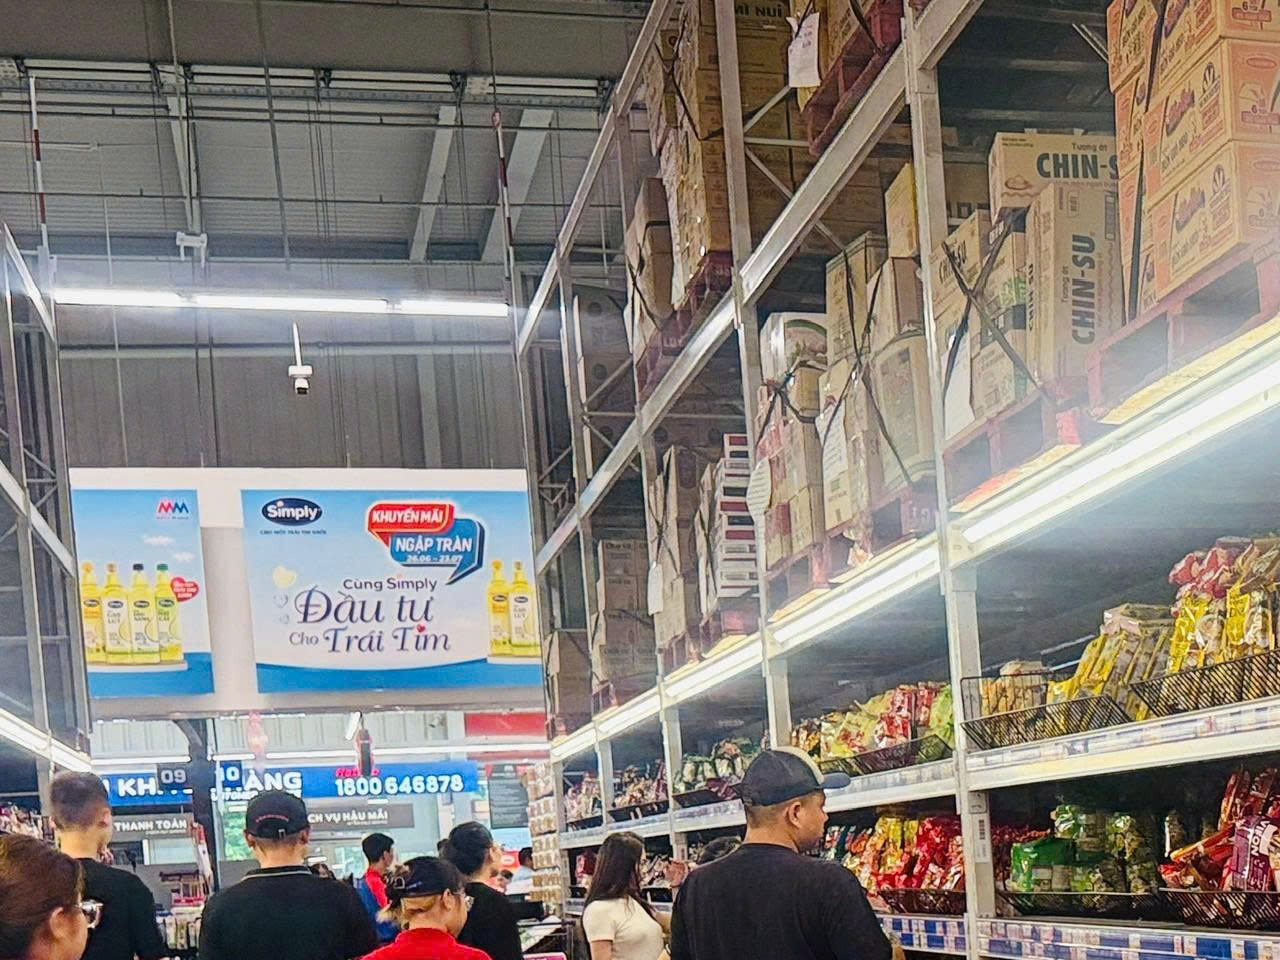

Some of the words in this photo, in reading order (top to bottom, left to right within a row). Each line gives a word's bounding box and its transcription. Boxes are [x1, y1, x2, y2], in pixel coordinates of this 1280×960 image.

[1036, 153, 1118, 180] CHIN-S
[1072, 233, 1096, 345] CHIN-SU
[266, 500, 319, 521] Simply
[395, 536, 434, 557] NGẬP
[436, 535, 473, 552] TRÀN
[343, 577, 384, 592] Cùng
[386, 577, 438, 592] Simply
[294, 584, 386, 624] Đầu
[396, 595, 435, 623] tư
[289, 631, 320, 646] Cho
[322, 626, 385, 653] Trái
[392, 624, 452, 653] Tim
[160, 769, 187, 784] 09
[335, 776, 382, 797] 1800
[385, 774, 464, 796] 646878
[114, 821, 154, 832] THANH
[156, 819, 188, 830] TOÁN
